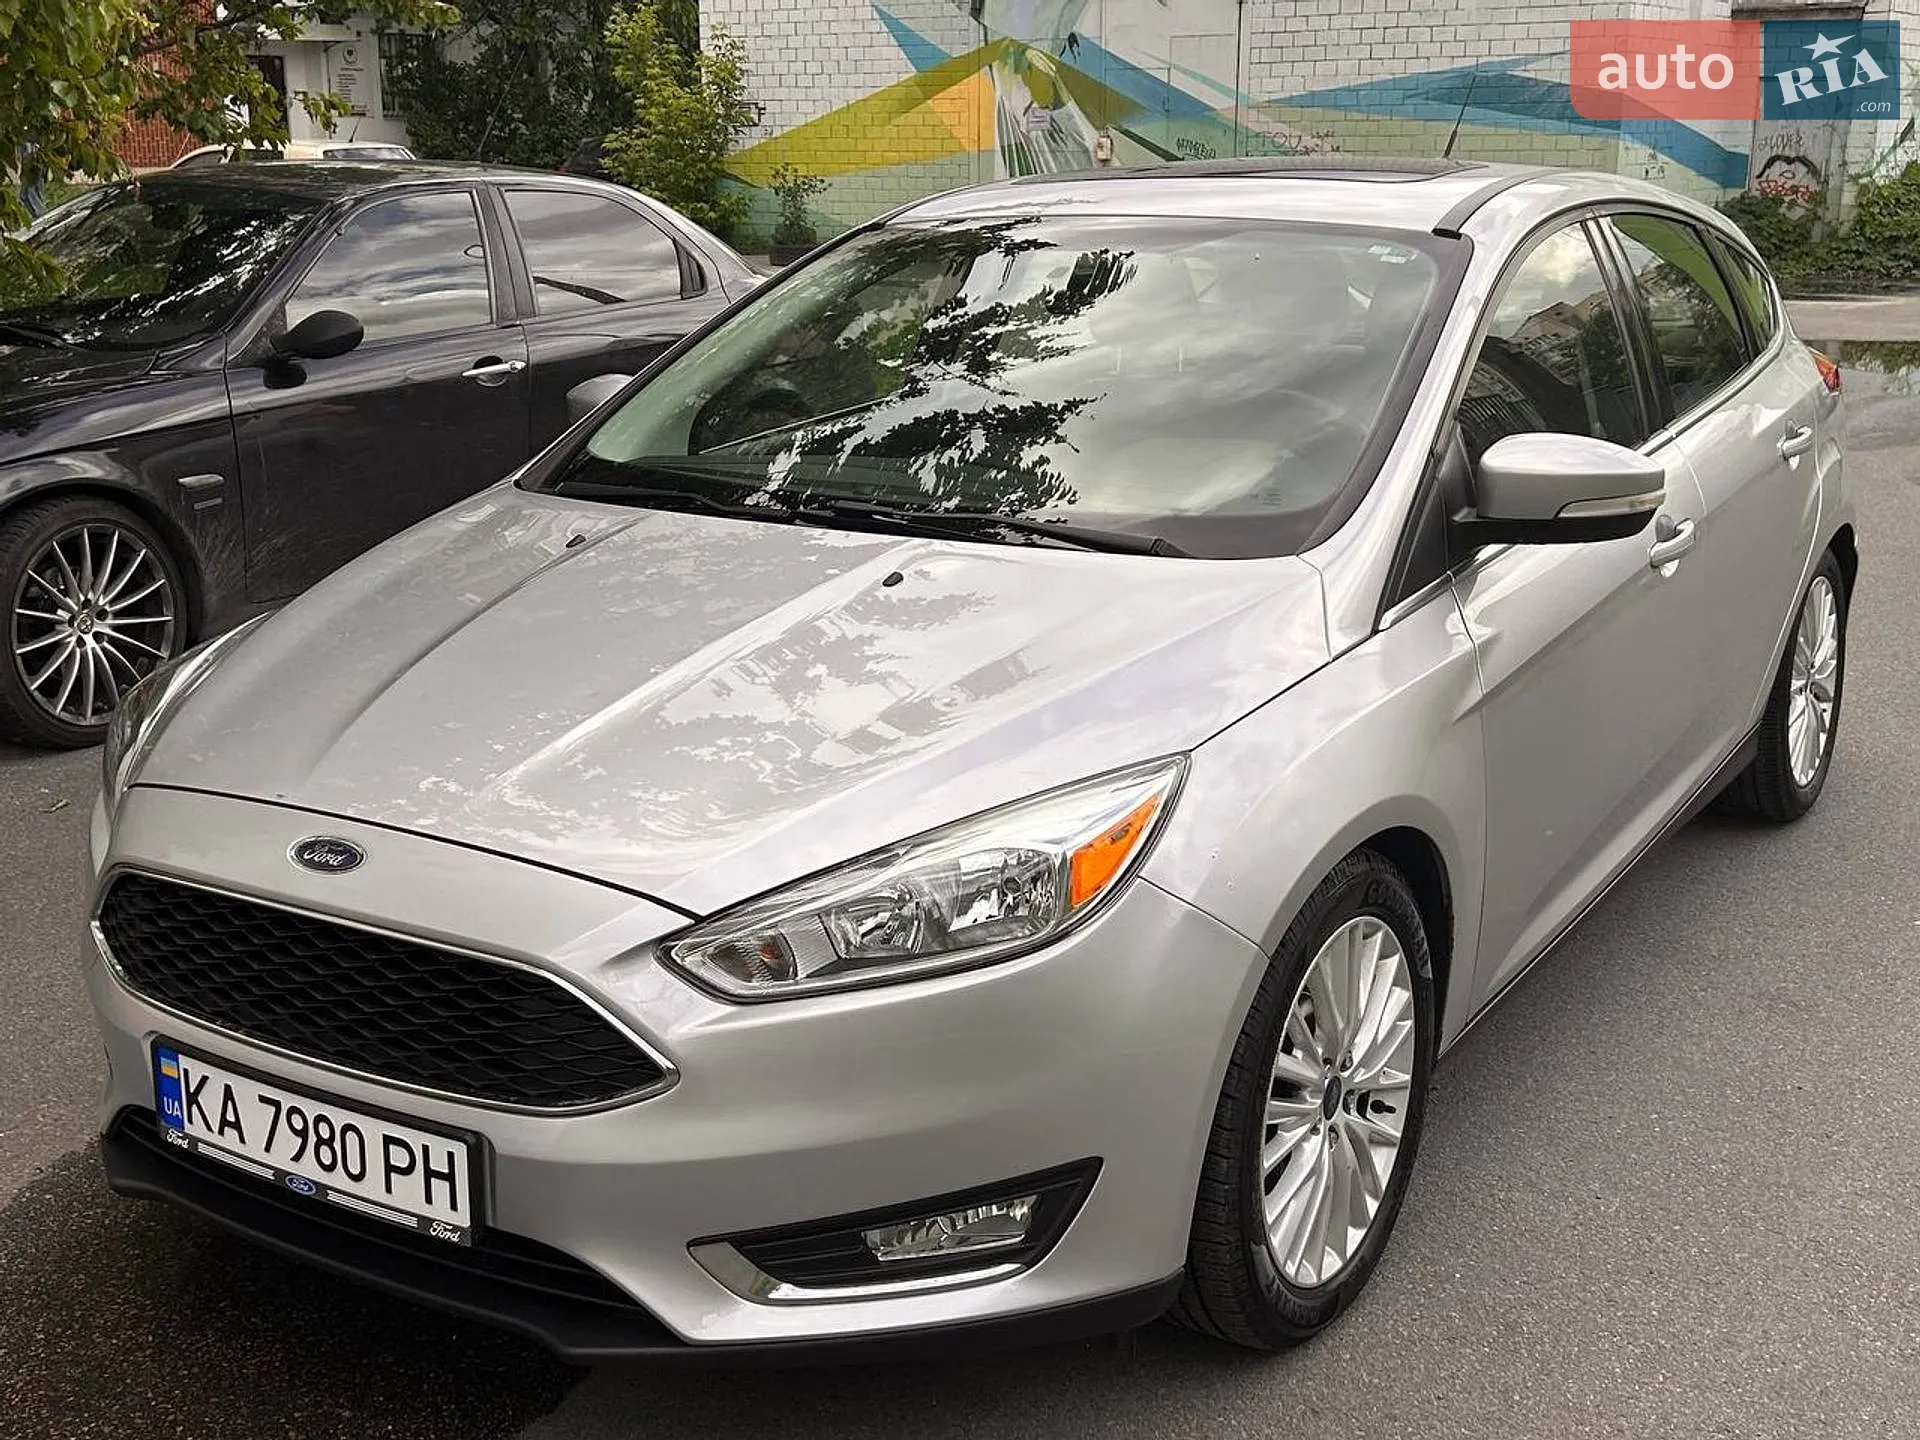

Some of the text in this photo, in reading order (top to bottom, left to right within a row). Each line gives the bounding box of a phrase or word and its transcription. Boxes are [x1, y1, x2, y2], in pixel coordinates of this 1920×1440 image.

[303, 844, 350, 866] Ford
[163, 1096, 182, 1118] UA
[167, 1128, 189, 1149] Ford
[183, 1068, 459, 1212] KA 7980 PH
[429, 1221, 461, 1243] Ford
